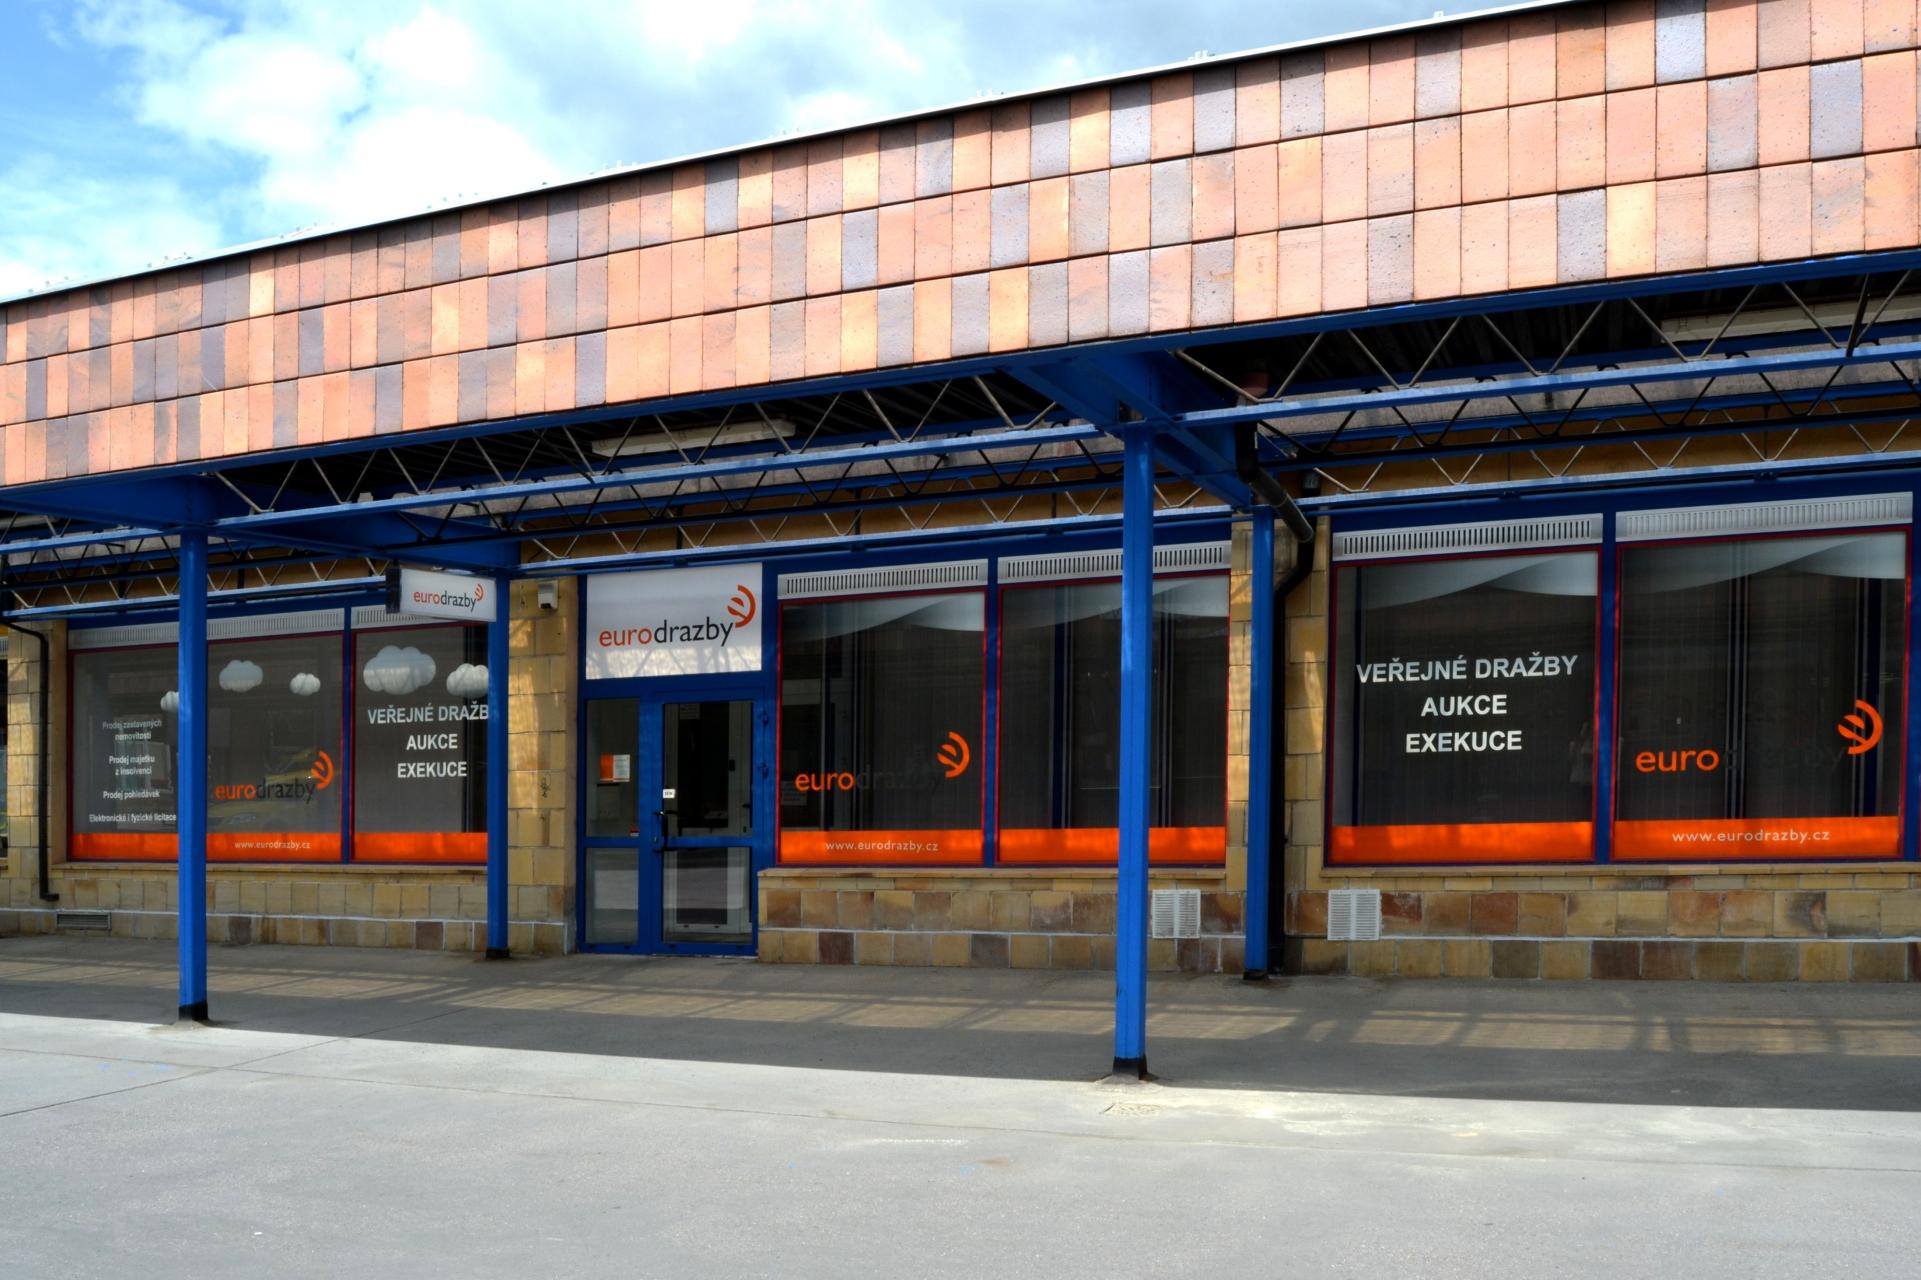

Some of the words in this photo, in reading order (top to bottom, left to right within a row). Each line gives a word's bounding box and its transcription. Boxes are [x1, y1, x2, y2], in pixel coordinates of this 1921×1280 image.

[413, 589, 476, 612] eurodrazby
[599, 616, 734, 647] eurodrazby
[1356, 655, 1467, 683] VEŘEJNÉ
[1475, 652, 1578, 679] DRAŽBY
[367, 702, 434, 724] VEŘEJNÉ
[438, 700, 489, 721] DRAŽB
[1421, 694, 1507, 717] AUKCE
[406, 733, 458, 750] AUKCE
[1406, 730, 1522, 752] EXEKUCE
[108, 755, 129, 765] Prodej
[397, 761, 467, 778] EXEKUCE
[103, 790, 123, 800] Prodej
[214, 777, 317, 804] eurodrazby
[1671, 828, 1831, 843] www.eurodrazby.cz
[234, 841, 310, 850] www.eurodrazby.cz
[825, 840, 939, 853] www.eurodrazby.cz
